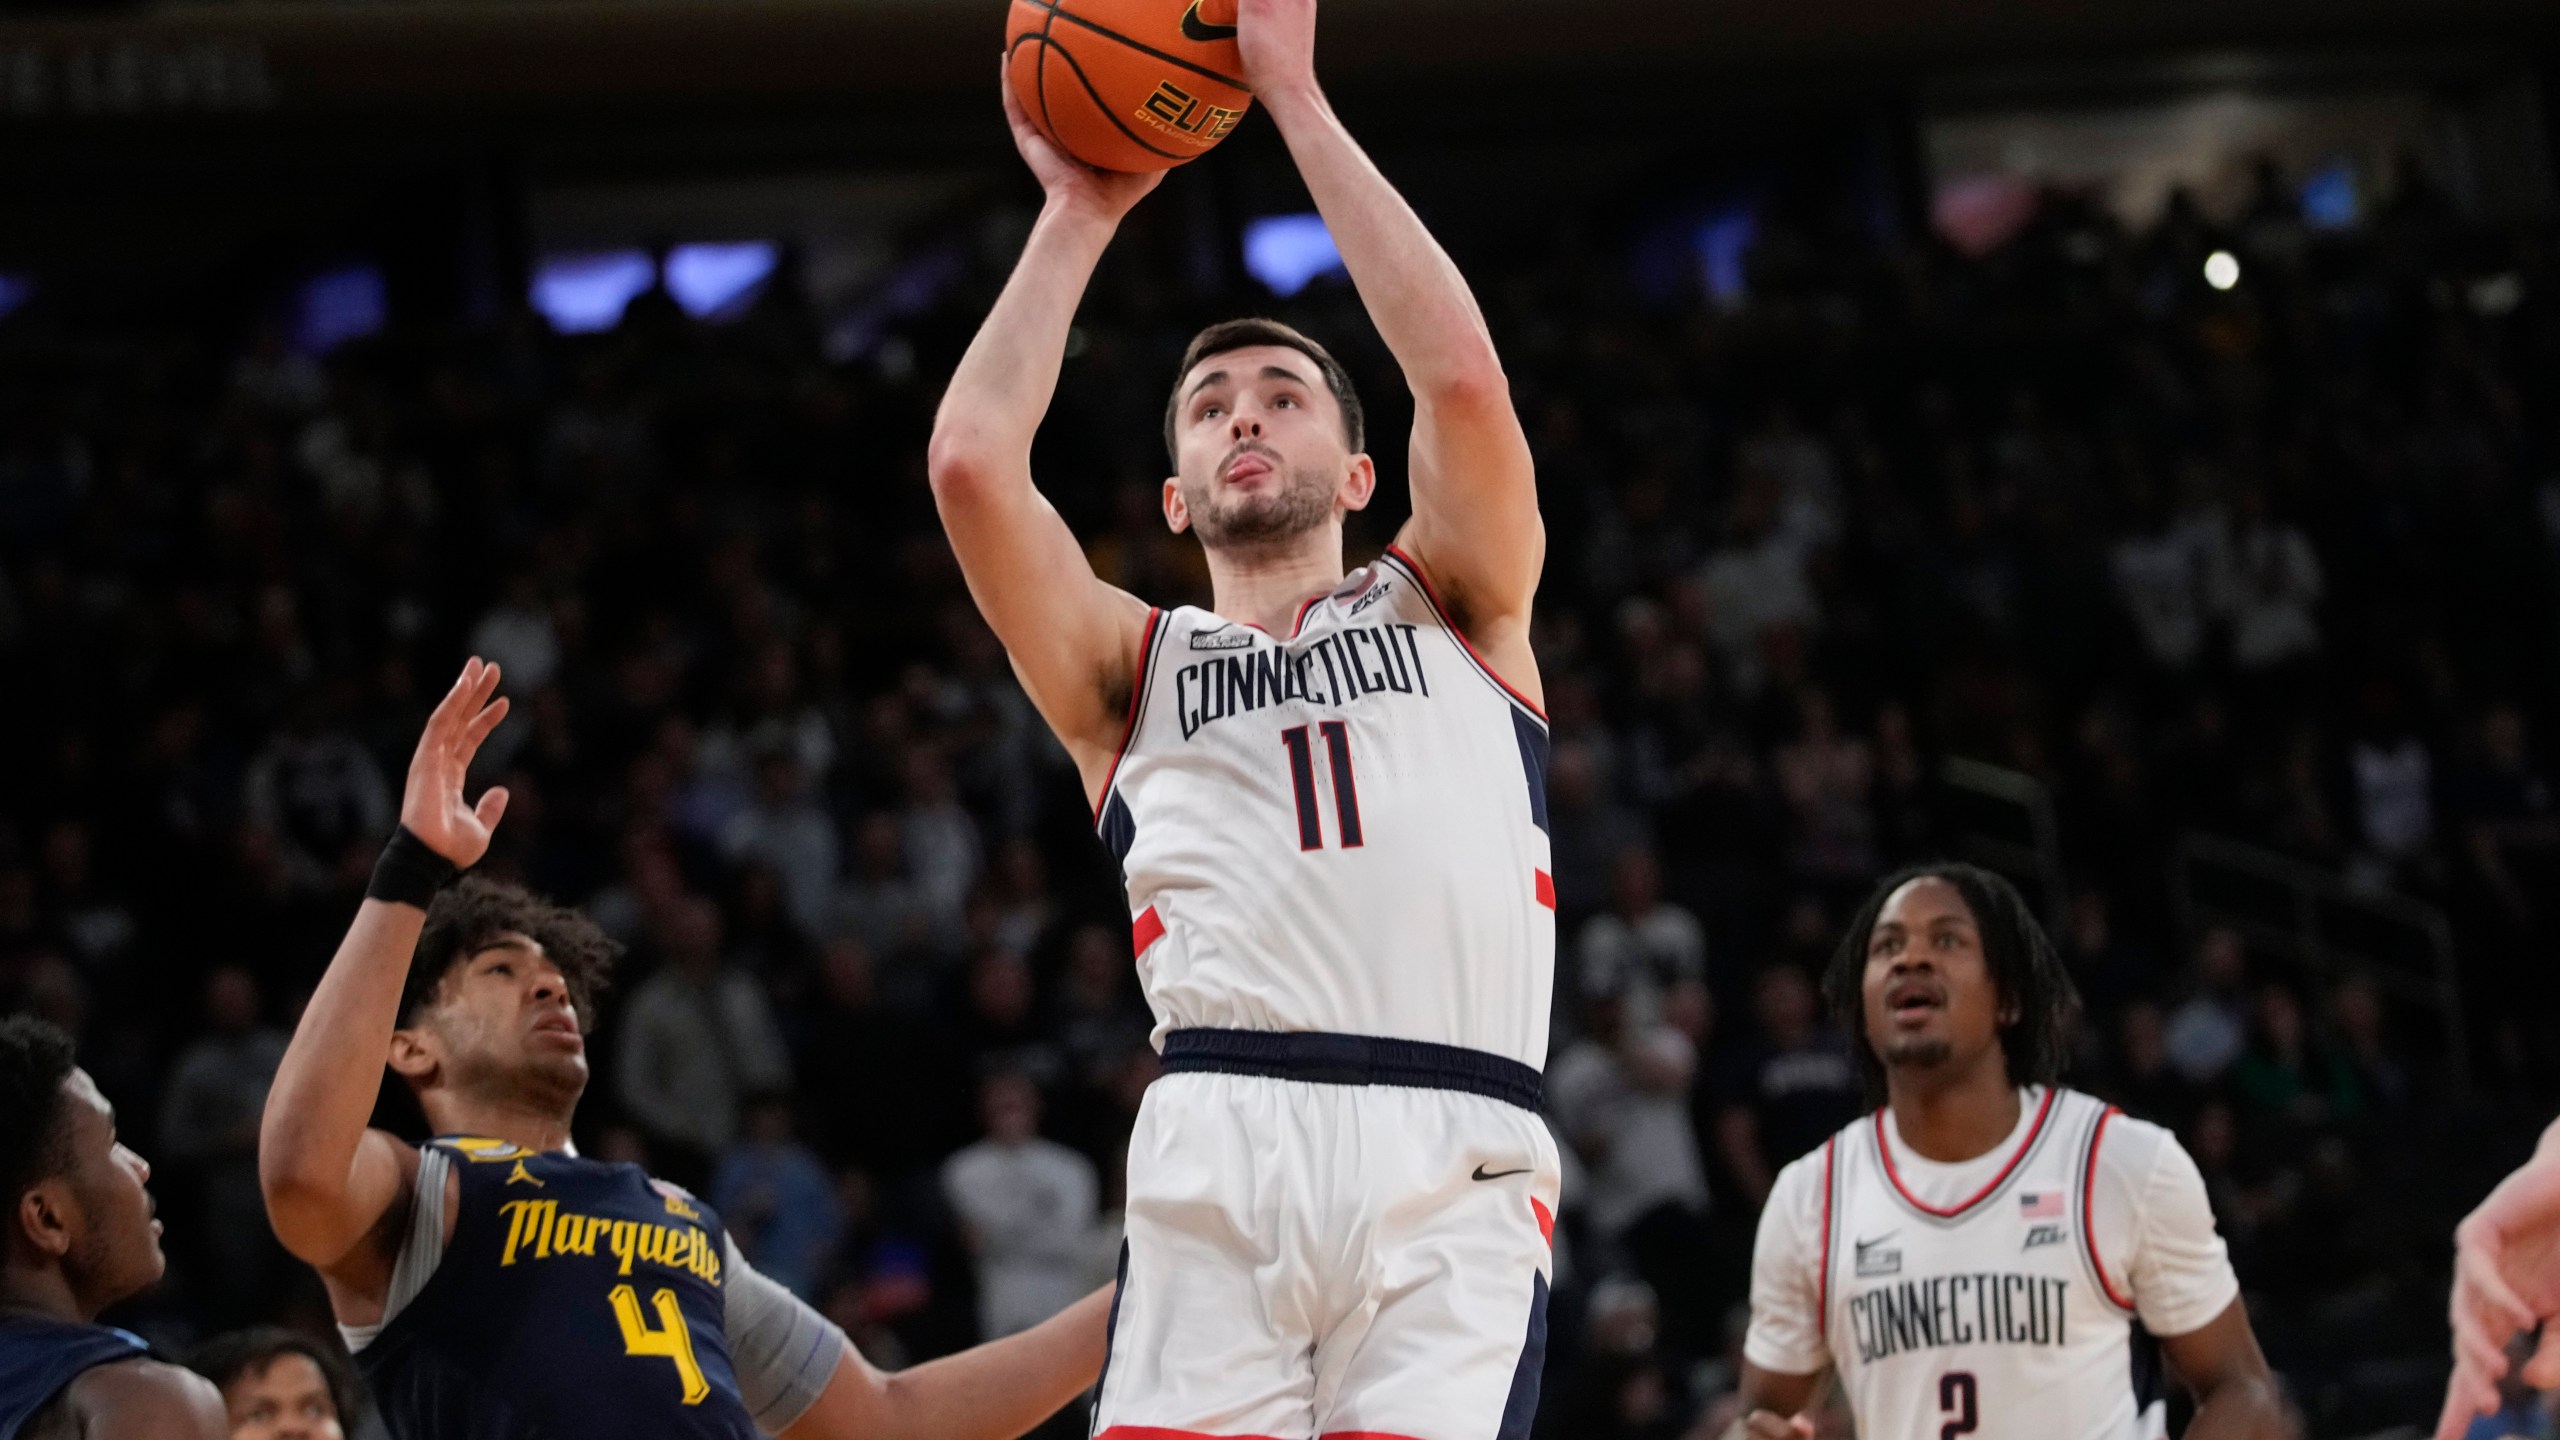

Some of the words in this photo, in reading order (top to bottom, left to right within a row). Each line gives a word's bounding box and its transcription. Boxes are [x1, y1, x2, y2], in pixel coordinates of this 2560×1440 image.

[1142, 79, 1246, 140] ELITE
[1176, 623, 1430, 741] CONNECTICUT
[1281, 720, 1364, 852] 11
[498, 1199, 722, 1287] Marquette
[608, 1284, 710, 1406] 4
[1850, 1273, 2070, 1365] CONNECTICUT
[1939, 1370, 1979, 1440] 2
